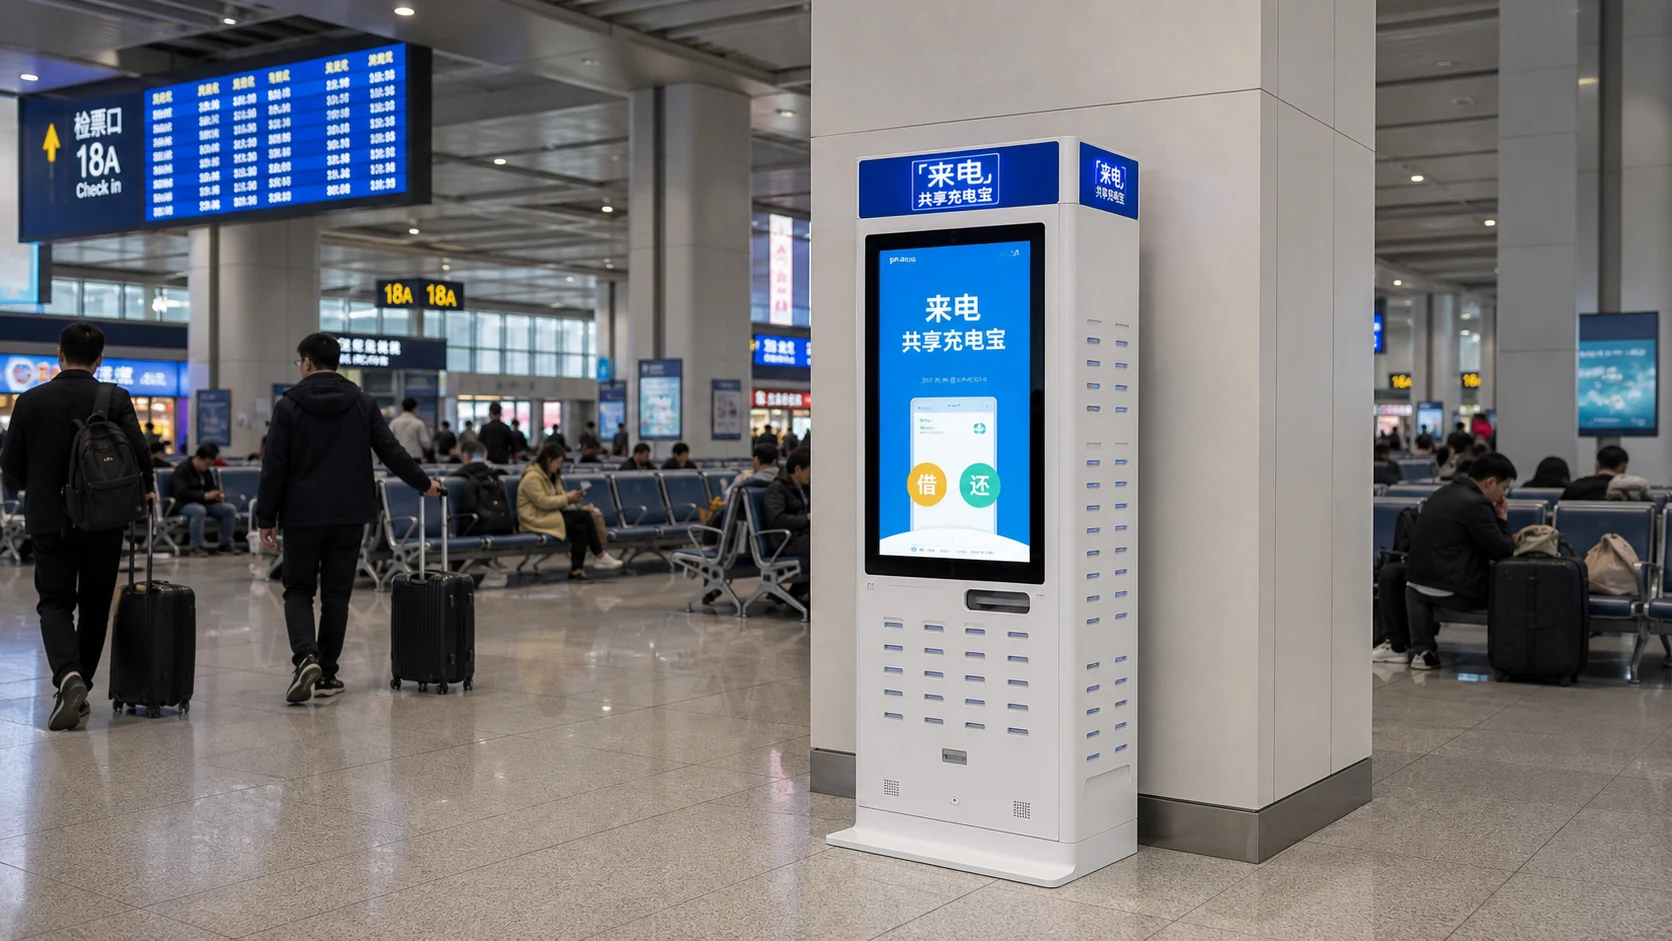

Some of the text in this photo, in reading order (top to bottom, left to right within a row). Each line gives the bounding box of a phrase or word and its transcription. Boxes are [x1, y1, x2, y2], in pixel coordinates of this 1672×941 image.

[74, 107, 122, 141] 检票口
[76, 142, 121, 178] 18A
[76, 178, 122, 199] Check in
[918, 187, 993, 208] 共享充电宝
[384, 283, 413, 305] 18A
[426, 284, 457, 307] 18A
[925, 293, 981, 323] 来电
[902, 328, 1006, 353] 共享充电宝
[917, 474, 937, 496] 借
[970, 475, 990, 496] 还
